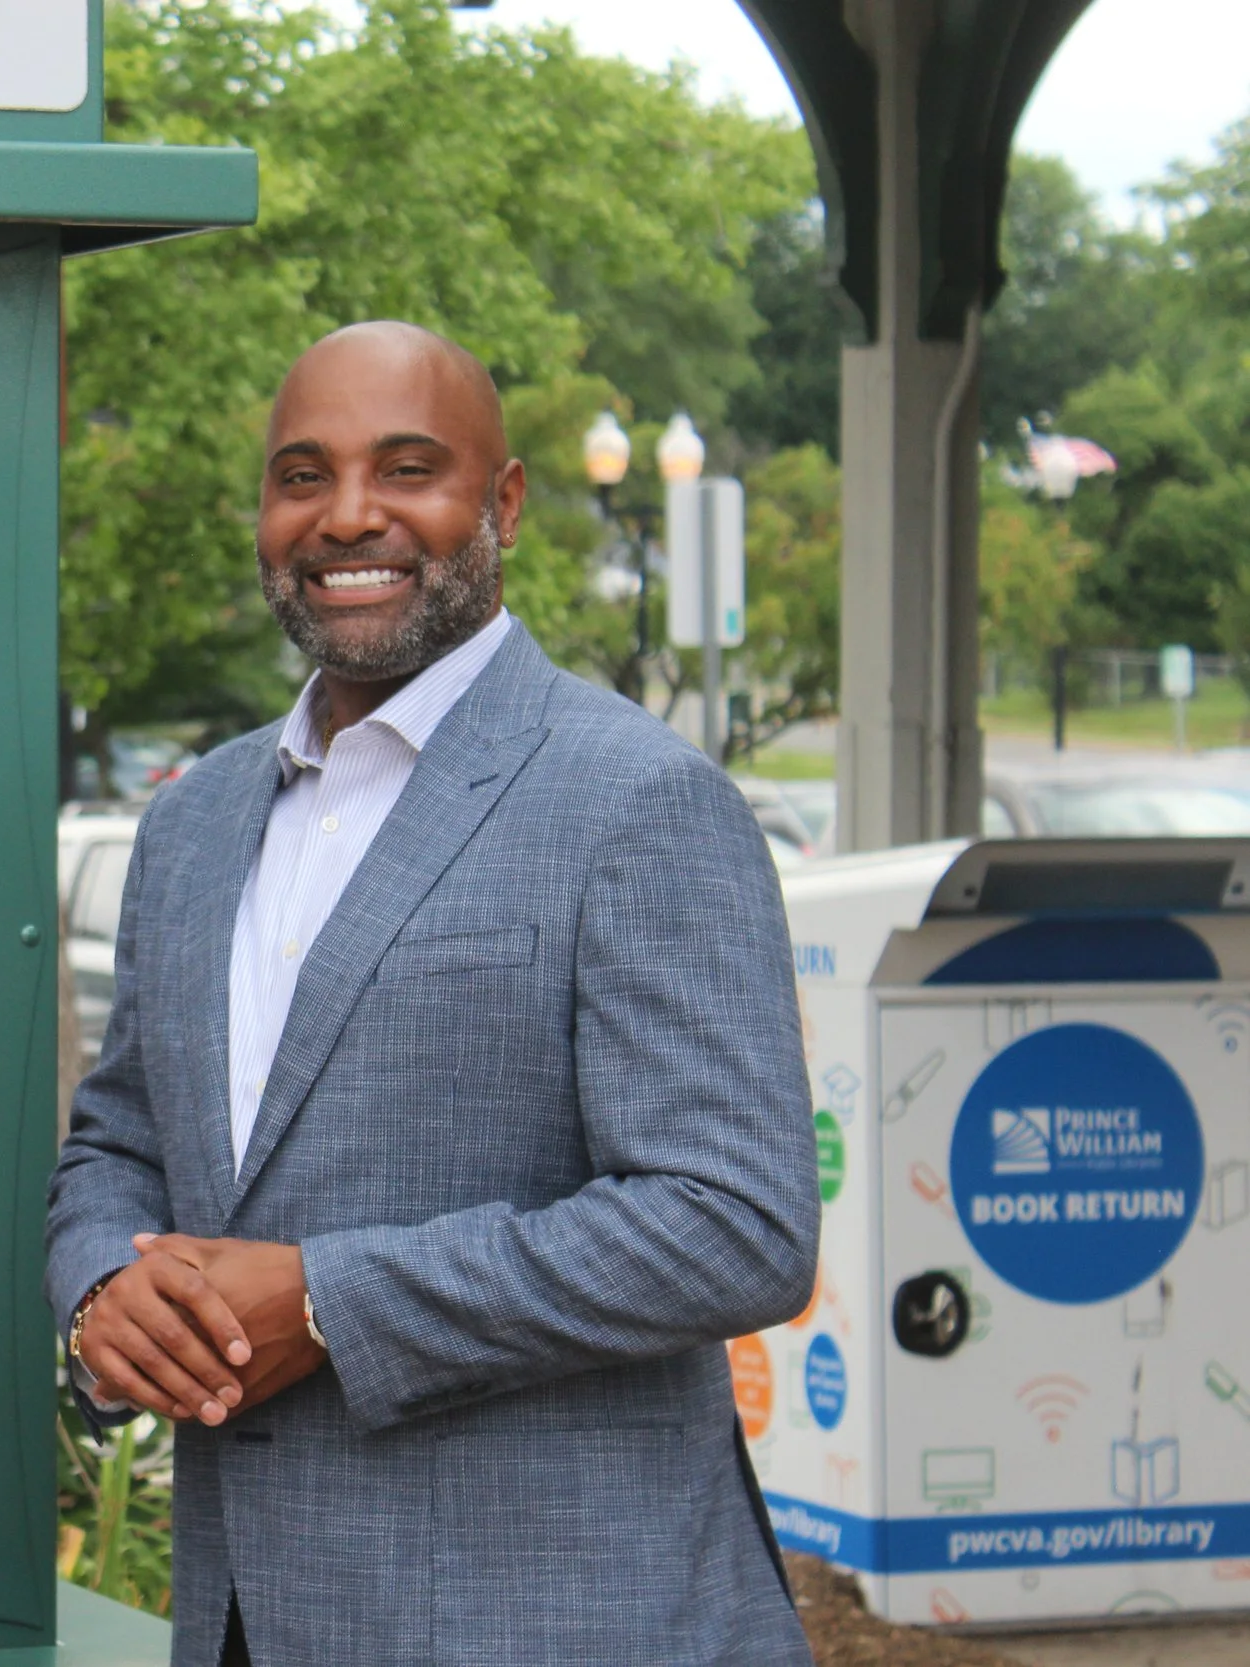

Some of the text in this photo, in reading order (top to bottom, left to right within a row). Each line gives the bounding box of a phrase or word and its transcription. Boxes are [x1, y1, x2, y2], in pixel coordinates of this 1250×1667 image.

[796, 944, 837, 976] URN
[1055, 1106, 1140, 1130] PRINCE
[1056, 1131, 1162, 1157] WILLIAM
[971, 1189, 1185, 1225] BOOK RETURN
[949, 1518, 1215, 1563] pwcva.gov/library
